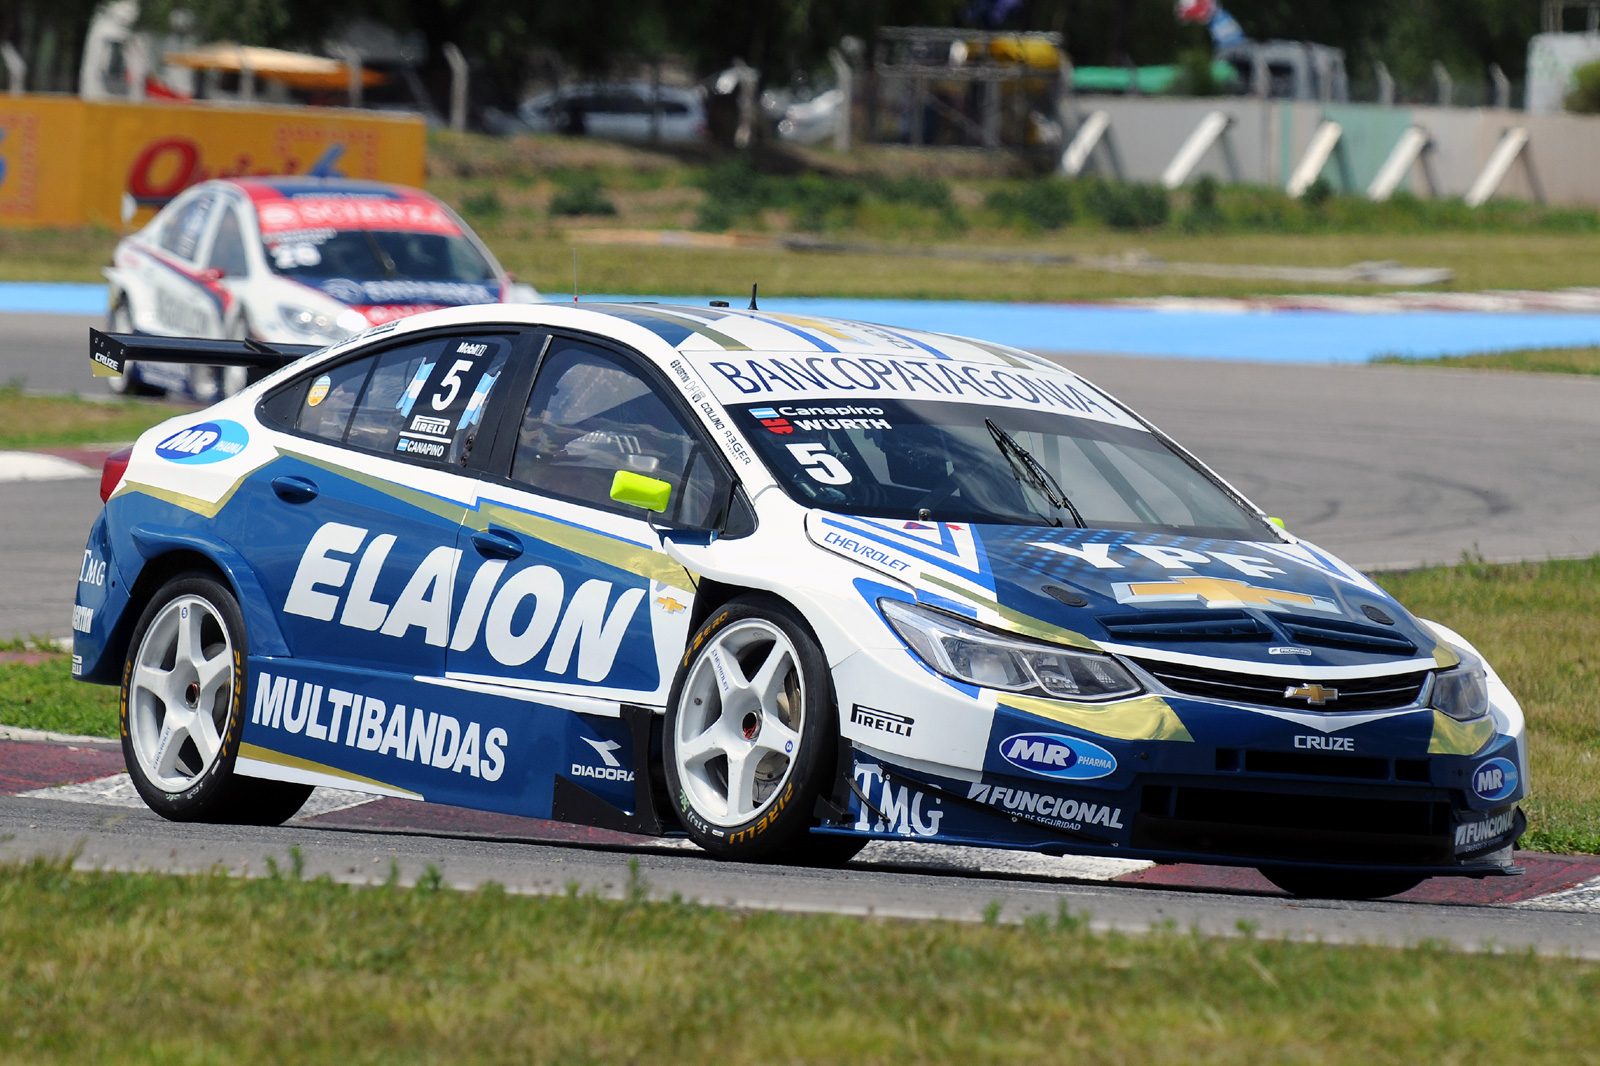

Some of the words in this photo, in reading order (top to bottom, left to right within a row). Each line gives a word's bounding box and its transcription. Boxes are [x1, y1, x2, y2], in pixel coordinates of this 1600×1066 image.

[95, 352, 119, 371] CRUZE
[432, 359, 473, 411] 5
[709, 357, 1117, 419] BANCOPATAGONIA
[410, 414, 451, 435] PIRELLI
[779, 405, 884, 416] Canapino
[157, 430, 218, 455] MR
[407, 440, 445, 458] CANAPINO
[785, 443, 853, 486] 5
[824, 532, 912, 571] CHEVROLET
[1024, 542, 1288, 579] YPF
[283, 521, 647, 683] ELAION
[251, 671, 508, 782] MULTIBANDAS
[850, 703, 915, 737] PIRELLI
[1007, 738, 1070, 767] MR
[1077, 755, 1112, 769] PHARMA
[1294, 735, 1355, 752] CRUZE
[571, 763, 636, 783] DIADORA
[1477, 768, 1503, 793] MR
[729, 782, 793, 844] PIRELLI
[854, 763, 944, 836] TMG
[989, 786, 1124, 830] FUNCIONAL
